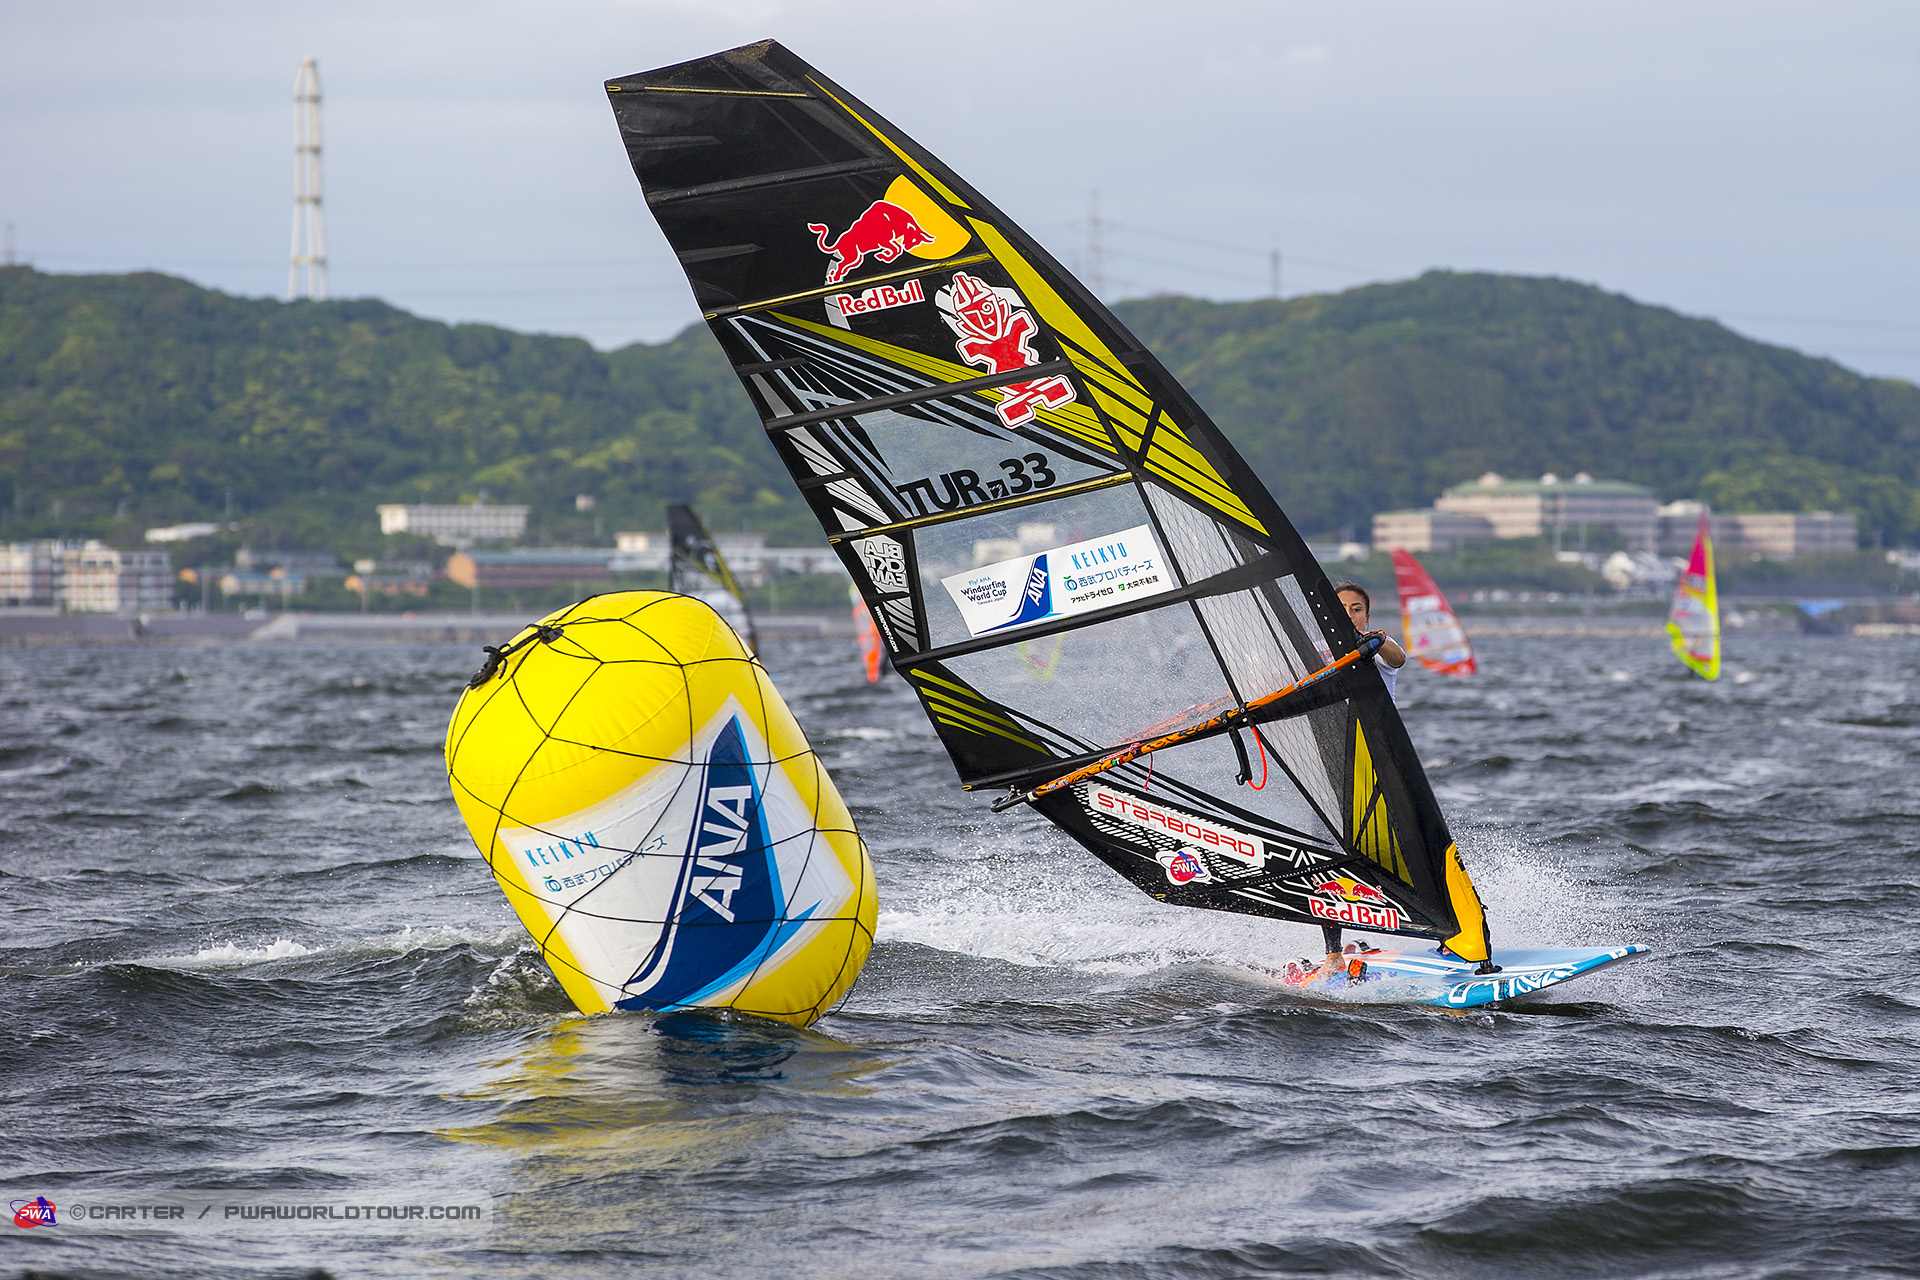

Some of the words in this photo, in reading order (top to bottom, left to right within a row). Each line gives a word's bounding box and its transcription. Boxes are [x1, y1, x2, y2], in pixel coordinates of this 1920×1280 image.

[838, 287, 882, 316] Red
[882, 280, 924, 308] Bull
[999, 452, 1056, 495] 33
[1071, 542, 1128, 570] KEIKYU
[961, 580, 1007, 596] Windsurfing
[1026, 566, 1048, 606] ANA
[1078, 559, 1154, 588] 西武プロパティーズ
[967, 591, 991, 601] World
[992, 589, 1007, 597] Cup
[1071, 587, 1114, 604] アサヒドライゼロ
[524, 830, 600, 867] KEIKYU
[562, 834, 668, 889] 西武プロパティーズ
[690, 785, 752, 923] ANA
[1309, 898, 1353, 922] Red
[1358, 905, 1399, 929] Bull
